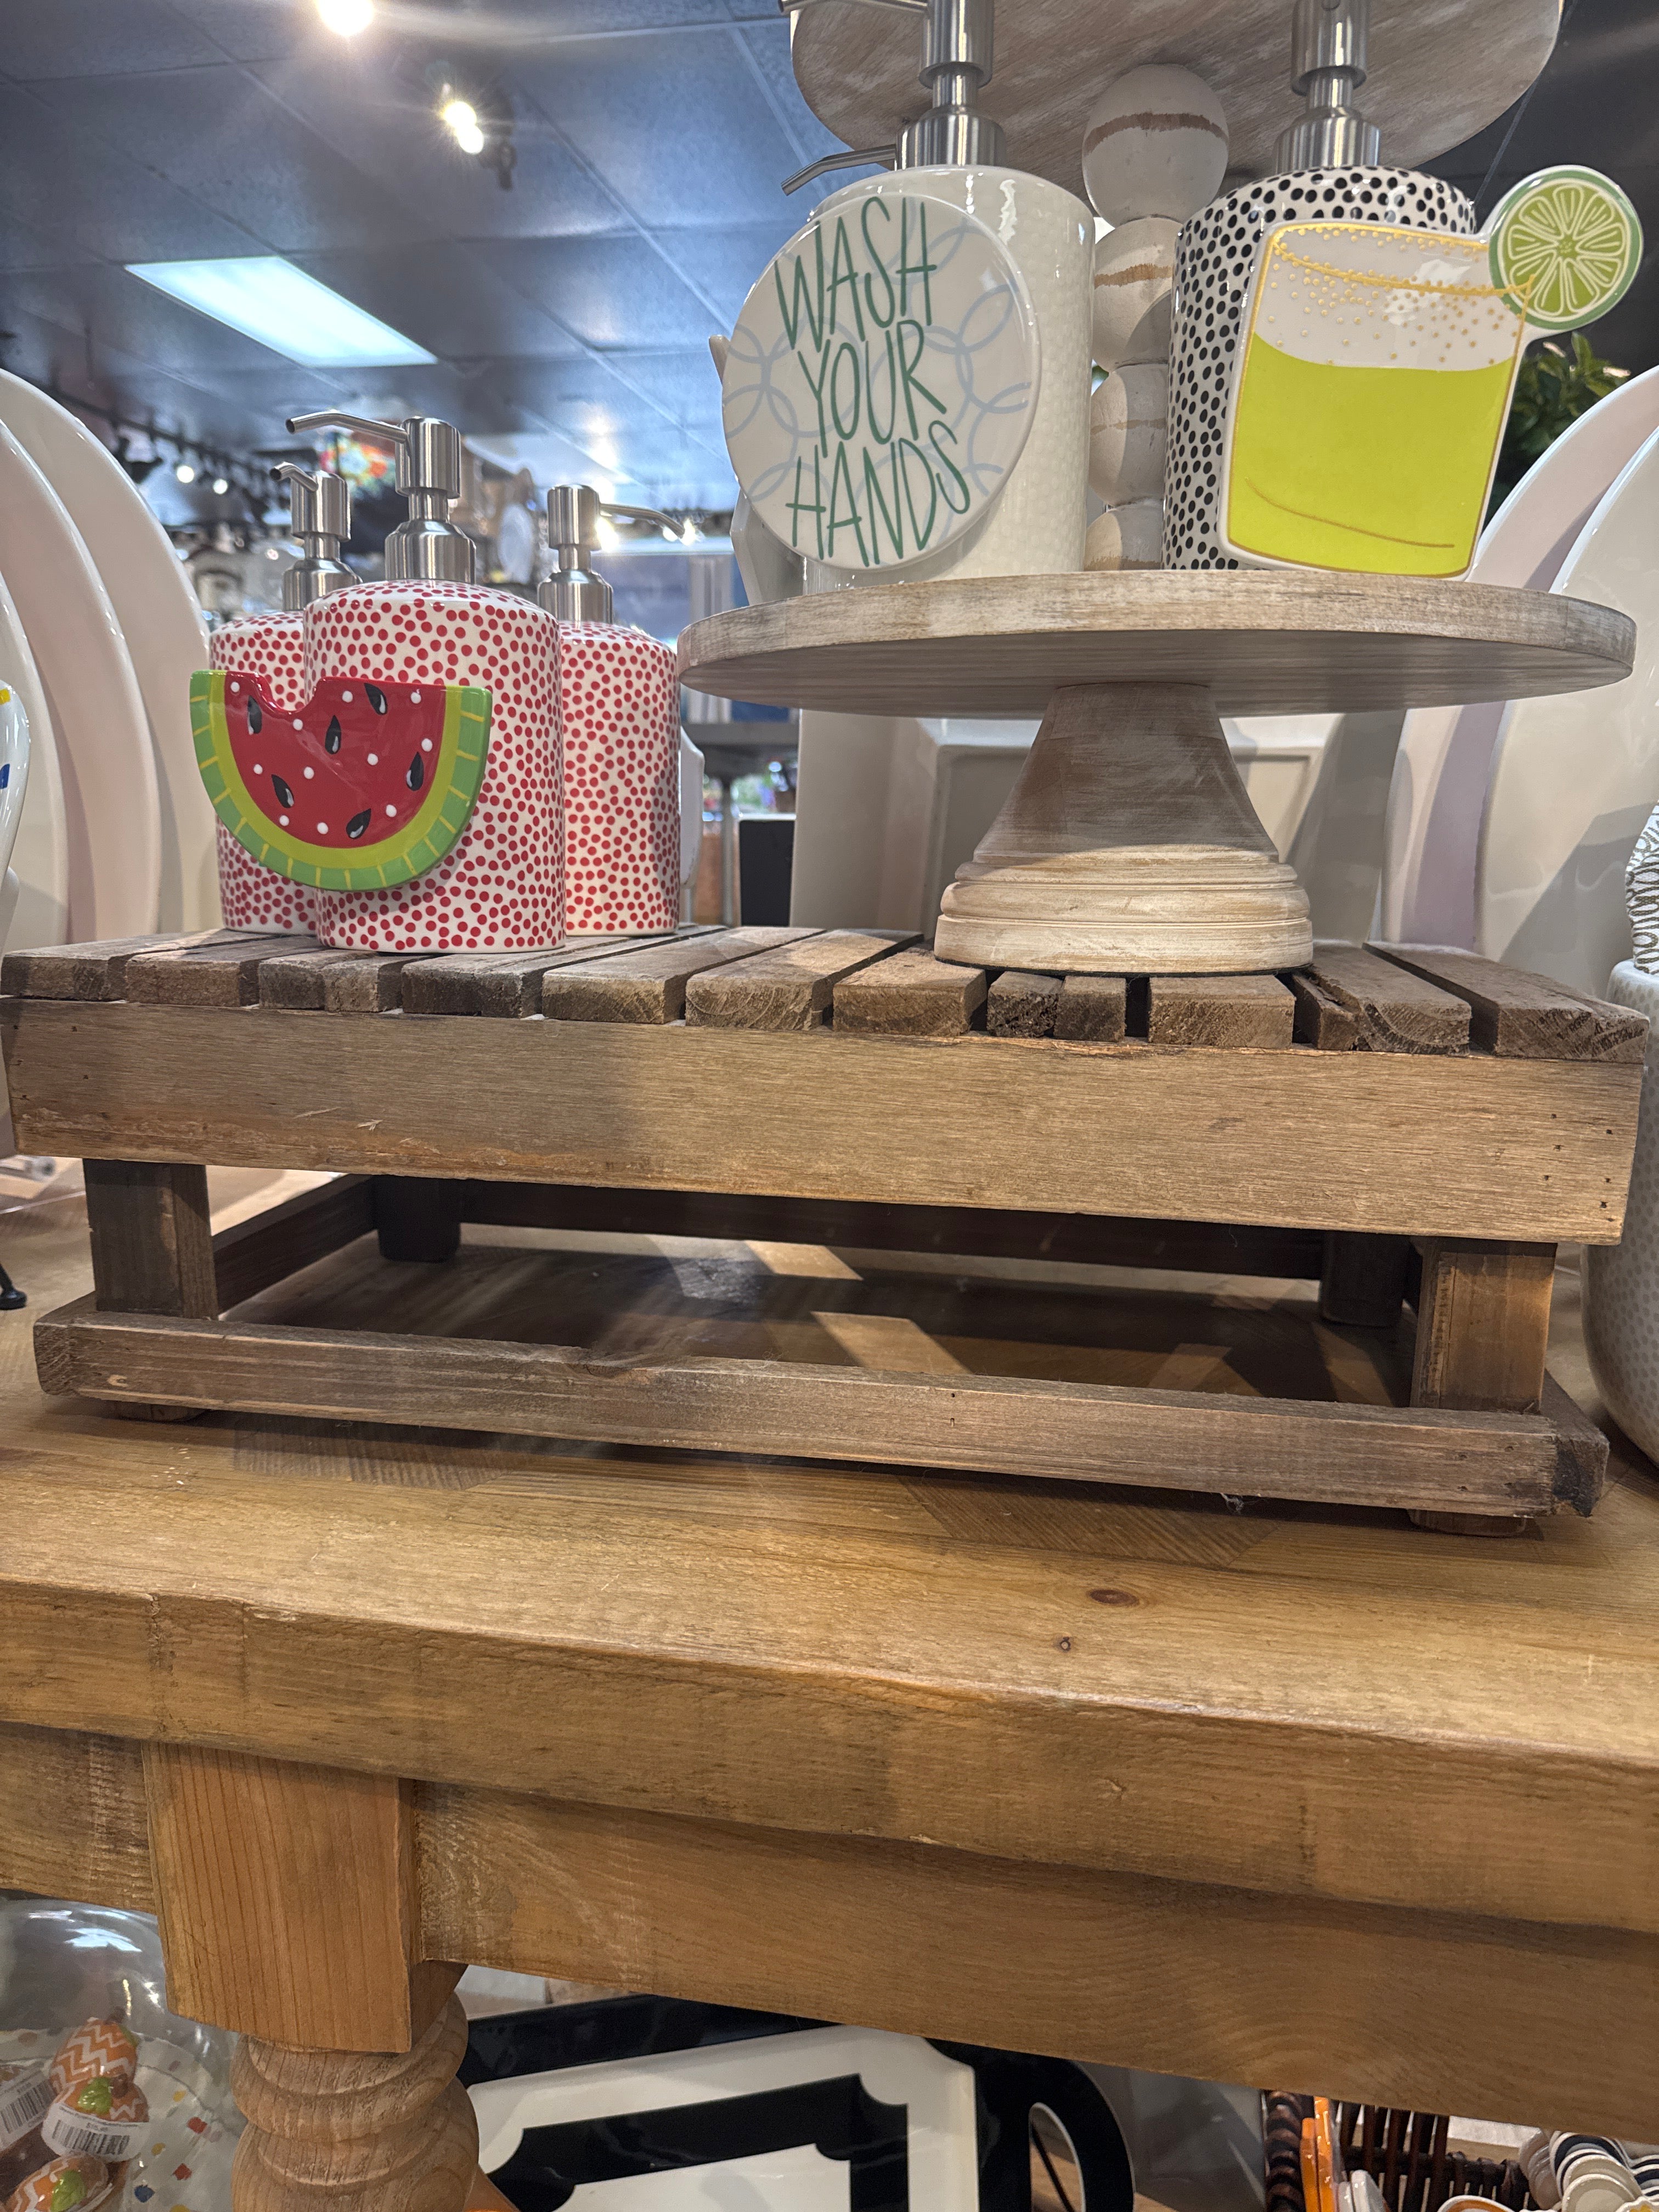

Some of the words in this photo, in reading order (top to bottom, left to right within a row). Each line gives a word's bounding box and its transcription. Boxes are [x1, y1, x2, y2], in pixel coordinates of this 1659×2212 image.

[774, 197, 937, 353] WASH
[798, 320, 947, 458] YOUR
[785, 420, 970, 567] HANDS
